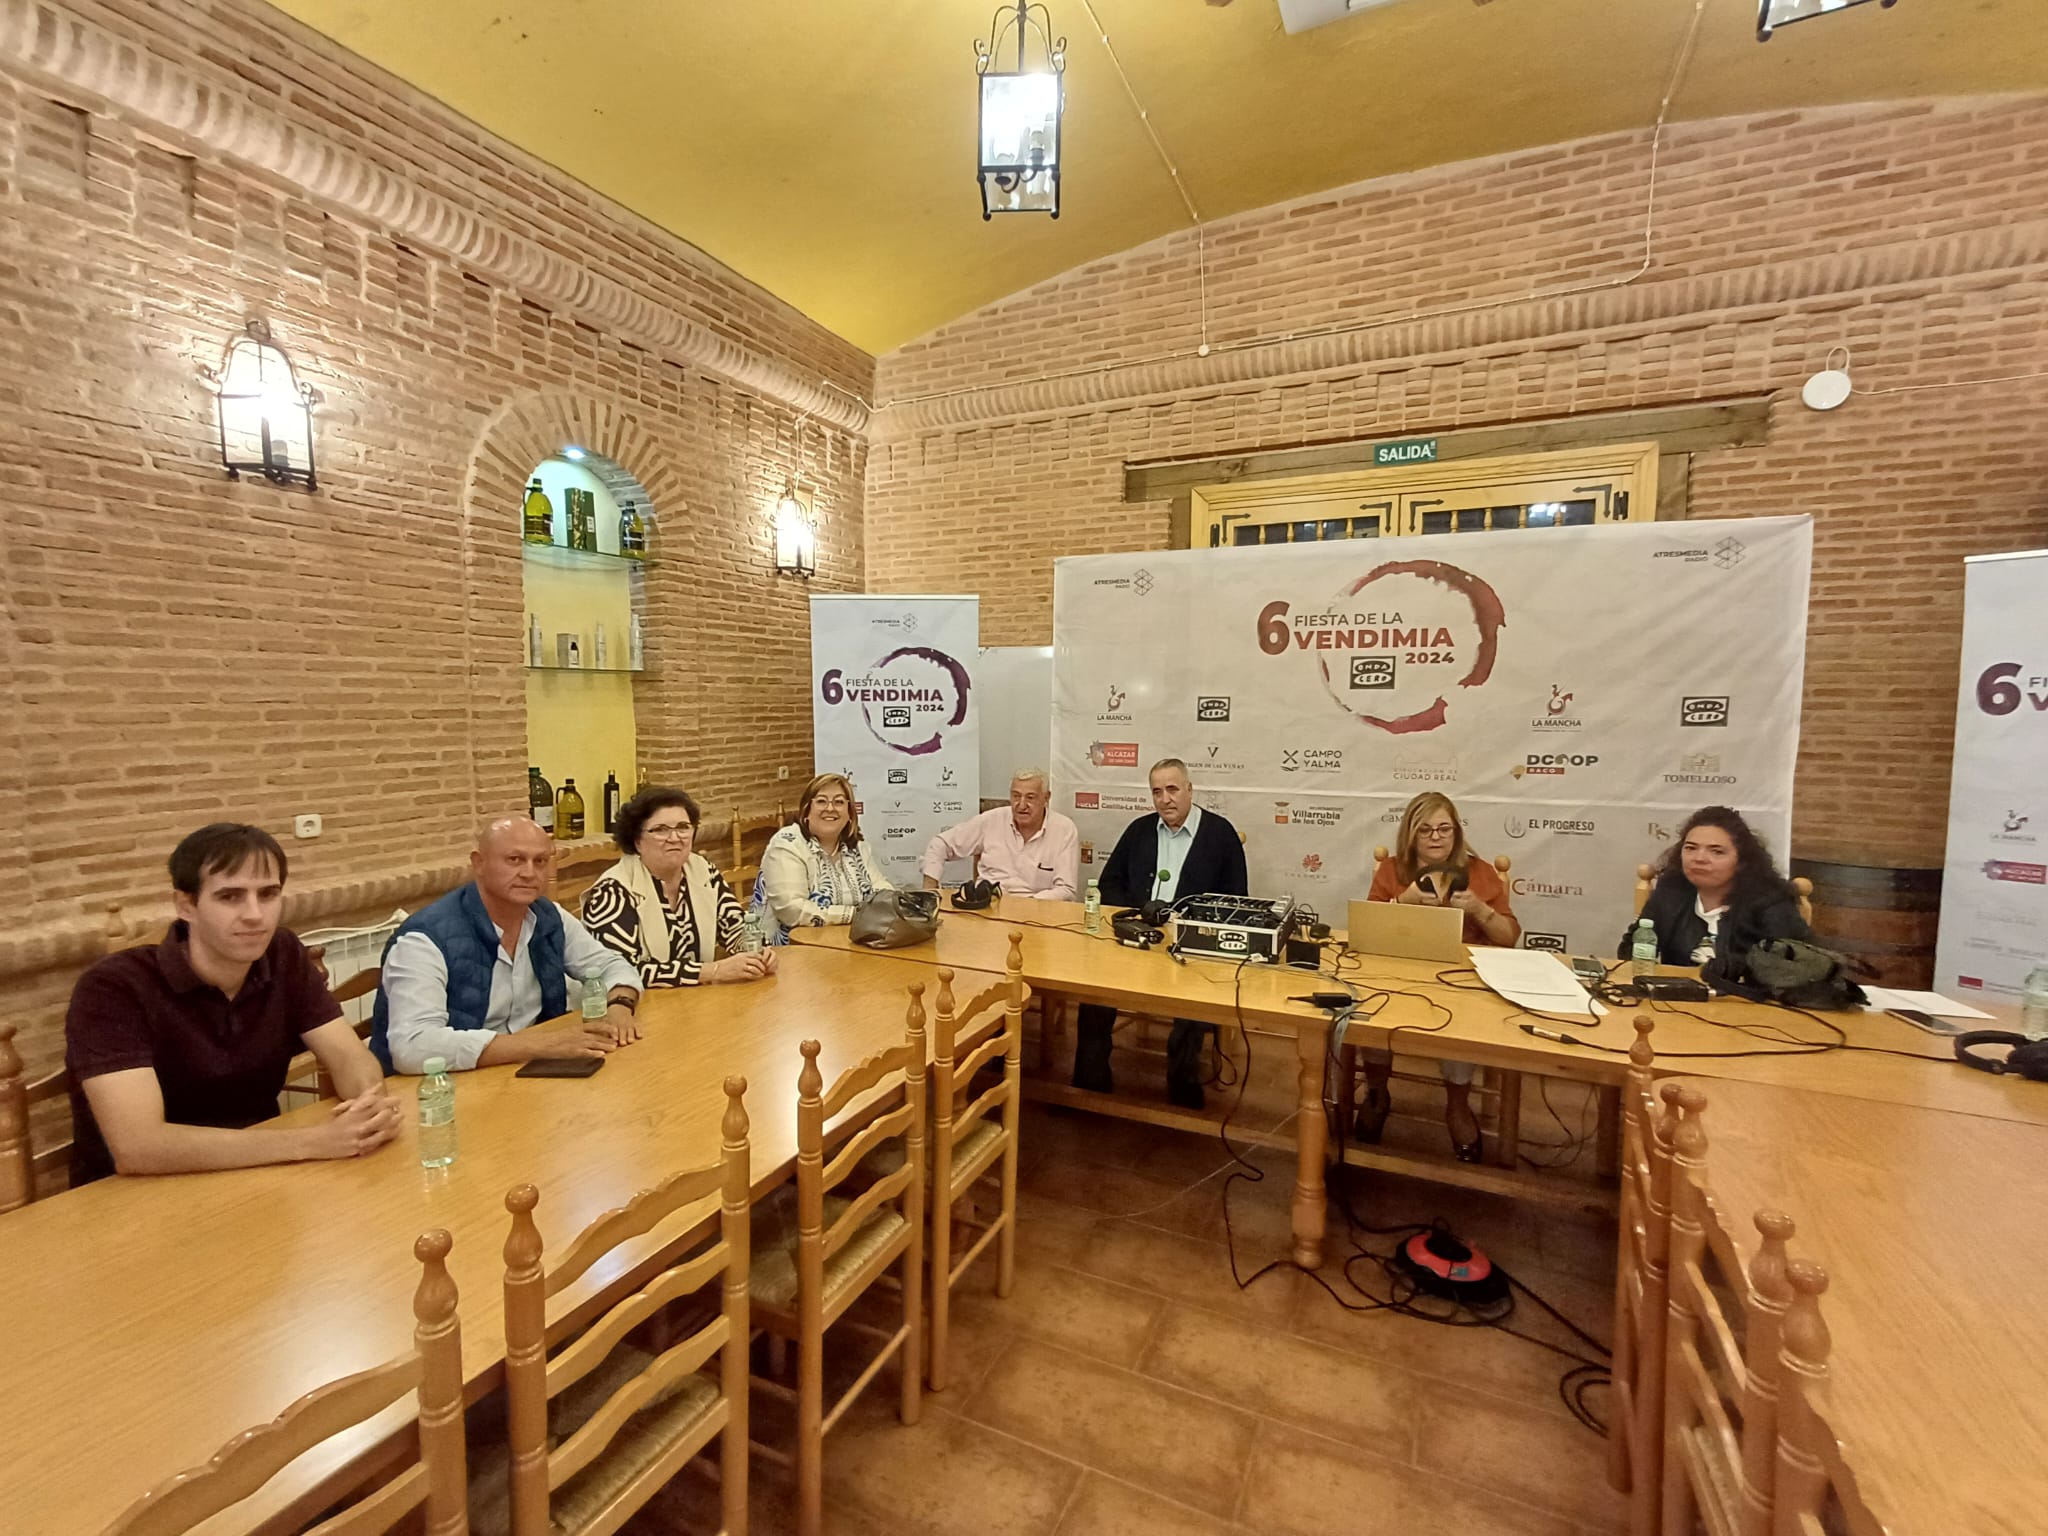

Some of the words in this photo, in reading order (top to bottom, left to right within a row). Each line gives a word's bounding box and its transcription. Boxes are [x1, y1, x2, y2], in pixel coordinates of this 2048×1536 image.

[1379, 444, 1432, 462] SALIDA
[1295, 614, 1349, 627] FIESTA
[1354, 613, 1377, 625] DE
[1382, 612, 1403, 625] LA
[1257, 601, 1290, 655] 6
[1294, 628, 1455, 649] VENDIMIA
[1405, 652, 1455, 664] 2024
[1357, 662, 1389, 672] ONDA
[846, 679, 880, 687] FIESTA
[884, 679, 898, 687] DE
[901, 679, 914, 687] LA
[1358, 673, 1388, 683] CERO
[822, 669, 844, 705] 6
[1976, 663, 2023, 715] 6
[846, 689, 944, 702] VENDIMIA
[915, 704, 944, 712] 2024
[1532, 719, 1542, 727] LA
[1544, 719, 1581, 727] MANCHA
[1304, 750, 1342, 758] CAMPO
[1393, 772, 1431, 781] CIUDAD
[1663, 774, 1737, 784] TOMELLOSO
[1292, 810, 1341, 820] Villarrubia
[1317, 819, 1335, 827] Ojos
[1528, 819, 1540, 829] EL
[1543, 819, 1595, 831] PROGRESO
[1512, 878, 1583, 896] Cámara
